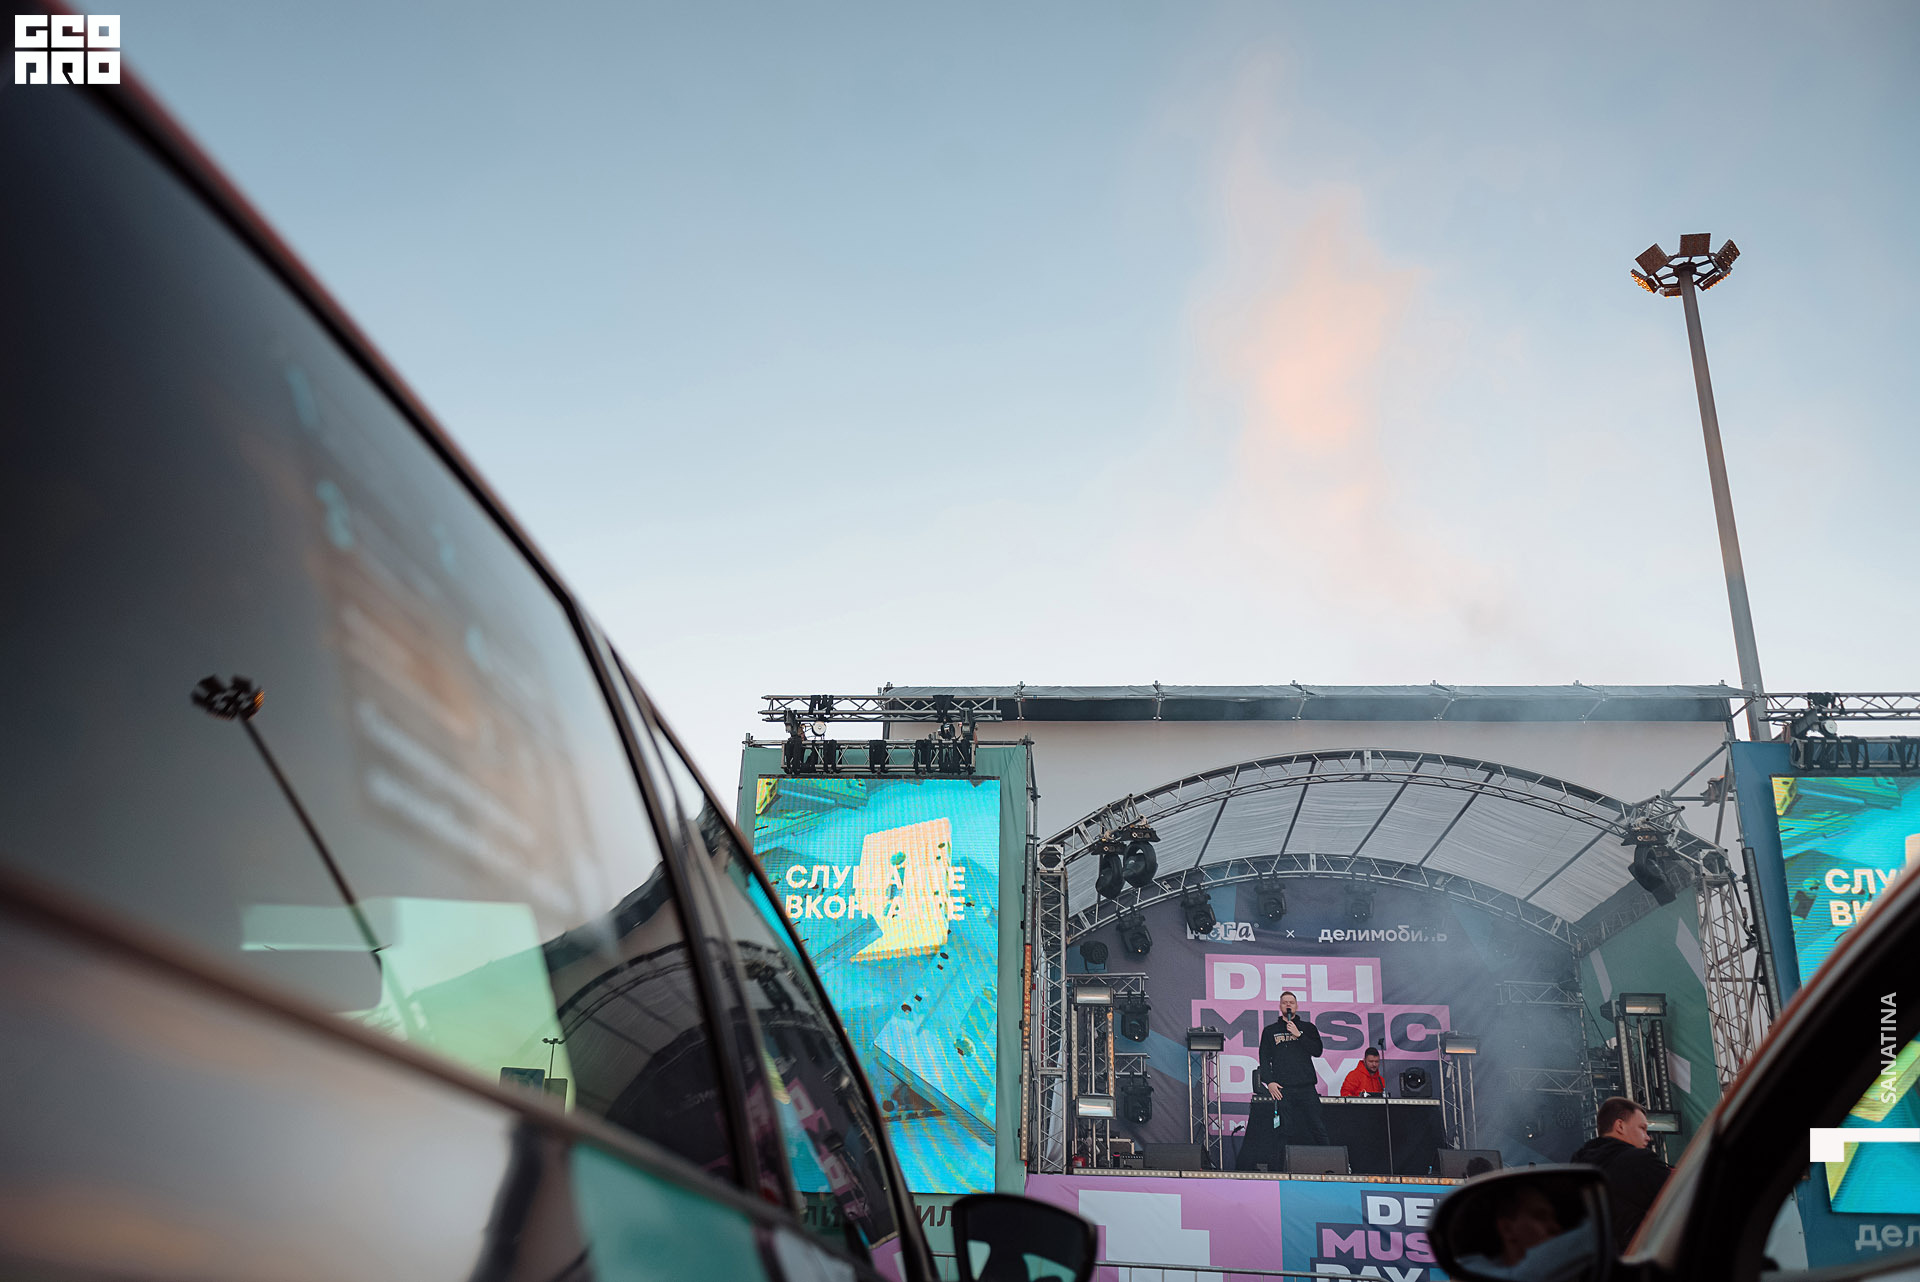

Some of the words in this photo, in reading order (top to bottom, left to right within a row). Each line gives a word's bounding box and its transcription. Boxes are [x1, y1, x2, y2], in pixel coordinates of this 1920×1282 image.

[785, 864, 966, 890] СЛУАЕ
[1824, 868, 1899, 895] СЛУ
[785, 894, 966, 920] ВКОНАЕ
[1829, 900, 1873, 926] ВК
[1213, 962, 1375, 1003] DELI
[1214, 1055, 1362, 1097] DY
[1366, 1195, 1441, 1227] DE
[1322, 1228, 1438, 1263] MUS
[1855, 1224, 1920, 1251] дел
